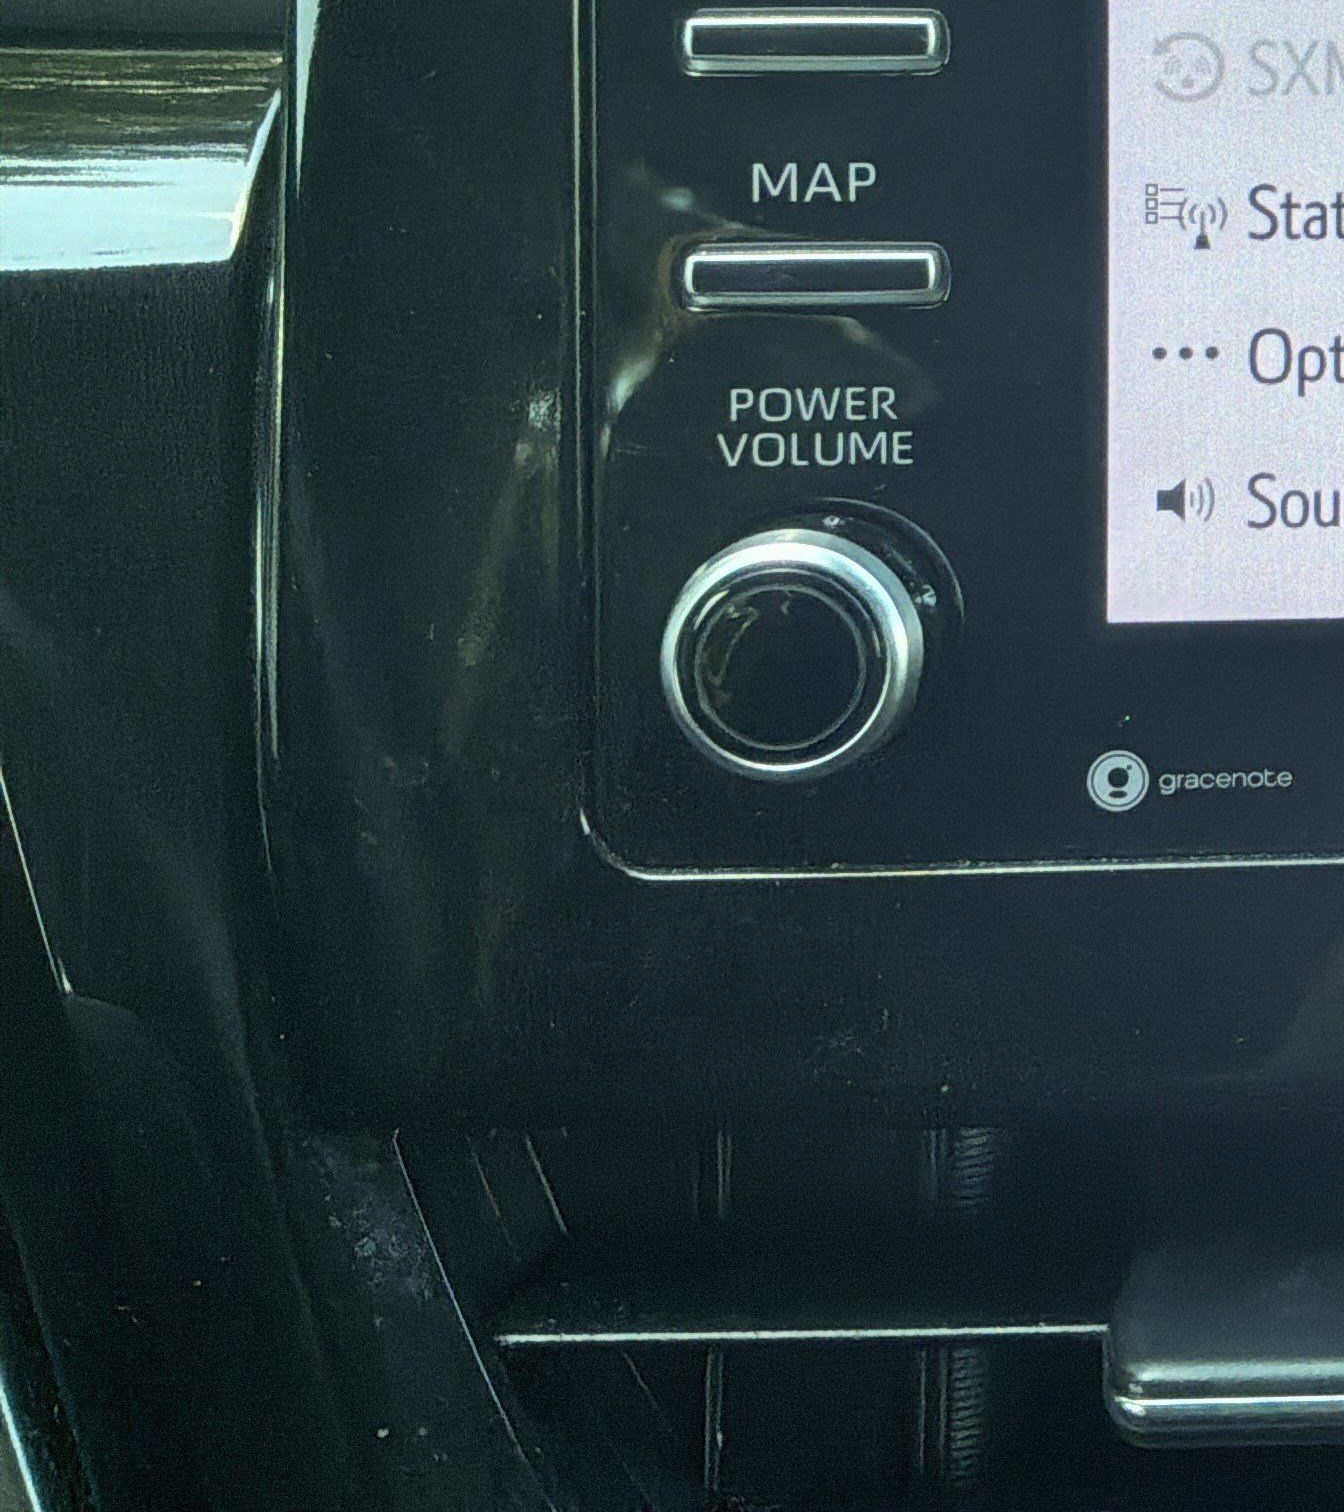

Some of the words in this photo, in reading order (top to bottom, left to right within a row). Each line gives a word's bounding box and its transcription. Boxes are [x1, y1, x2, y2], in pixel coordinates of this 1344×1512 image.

[752, 163, 875, 202] MAP
[731, 387, 896, 421] POWER
[718, 432, 912, 467] VOLUME
[1159, 770, 1292, 795] gracenote
